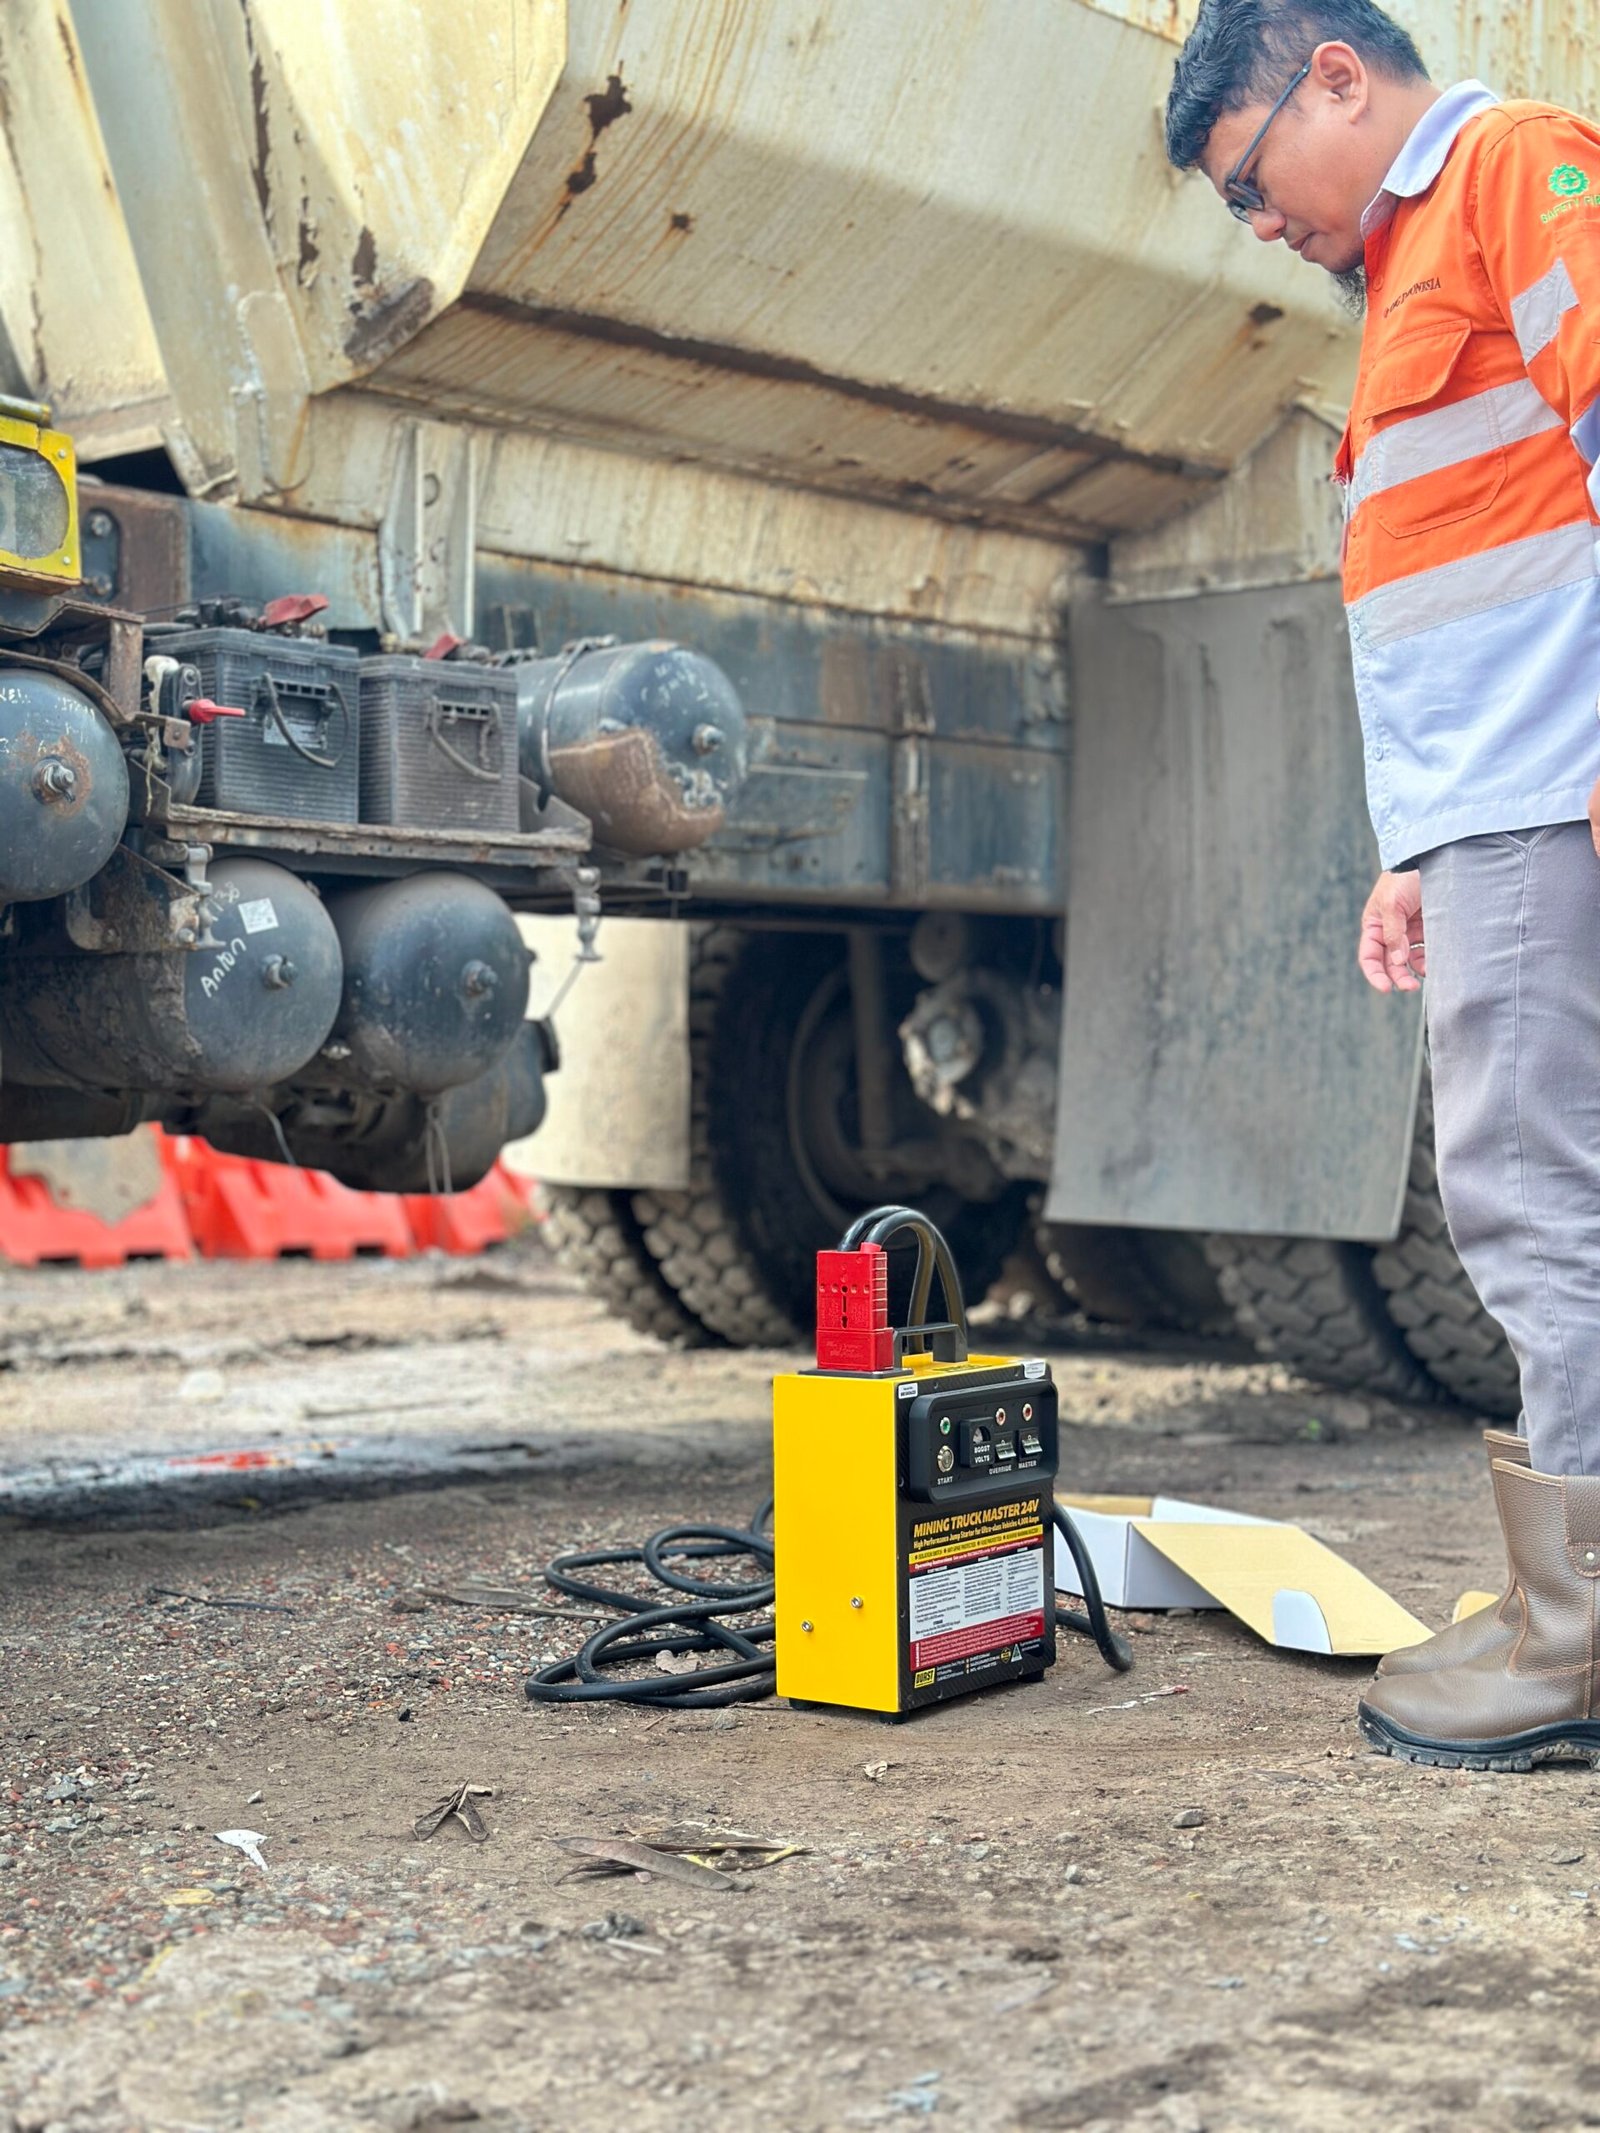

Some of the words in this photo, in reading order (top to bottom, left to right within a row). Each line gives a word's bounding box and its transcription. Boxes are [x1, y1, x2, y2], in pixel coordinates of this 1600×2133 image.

[1540, 197, 1579, 224] SAFETY
[974, 1444, 990, 1454] BOOST
[974, 1454, 990, 1463] VOLTS
[989, 1464, 1012, 1475] OVERRIDE
[1018, 1460, 1037, 1469] MASTER
[937, 1476, 953, 1485] START
[913, 1518, 949, 1538] MINING
[951, 1511, 981, 1529] TRUCK
[982, 1503, 1020, 1523] MASTER
[1020, 1499, 1039, 1514] 24V
[913, 1539, 923, 1550] High
[916, 1670, 933, 1683] DURST
